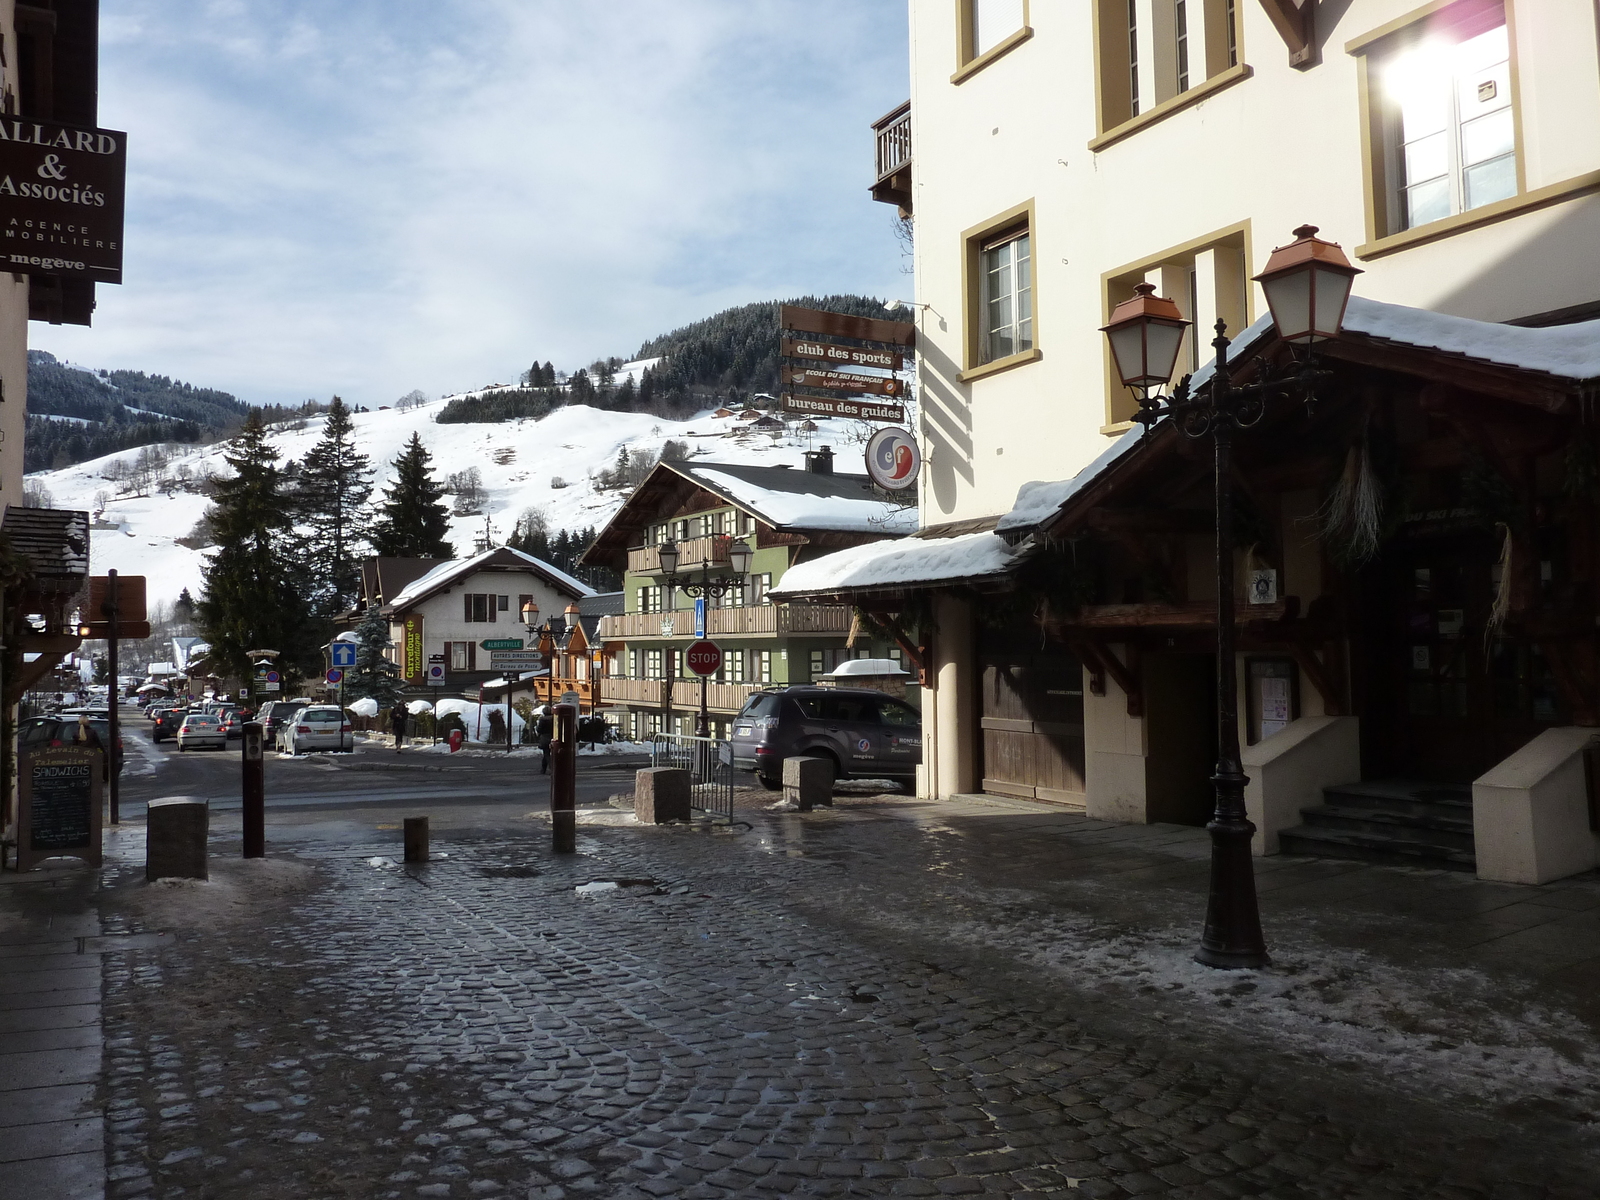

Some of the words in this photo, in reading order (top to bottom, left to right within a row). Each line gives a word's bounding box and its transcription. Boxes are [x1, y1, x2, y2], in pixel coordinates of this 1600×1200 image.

[37, 153, 67, 181] &
[0, 174, 105, 207] Associés
[10, 217, 88, 235] AGENCE
[10, 254, 85, 270] megève
[796, 343, 824, 356] club
[827, 347, 849, 359] des
[852, 352, 892, 365] sports
[805, 369, 826, 377] ECOLE
[851, 375, 884, 384] FRANÇAIS
[787, 396, 834, 412] bureau
[837, 402, 858, 414] des
[861, 406, 901, 419] guides
[406, 631, 414, 678] Carrefour
[690, 653, 718, 663] STOP
[29, 751, 41, 759] Au
[46, 746, 79, 755] Levain
[83, 749, 95, 757] du
[32, 765, 90, 778] SANDWICHS
